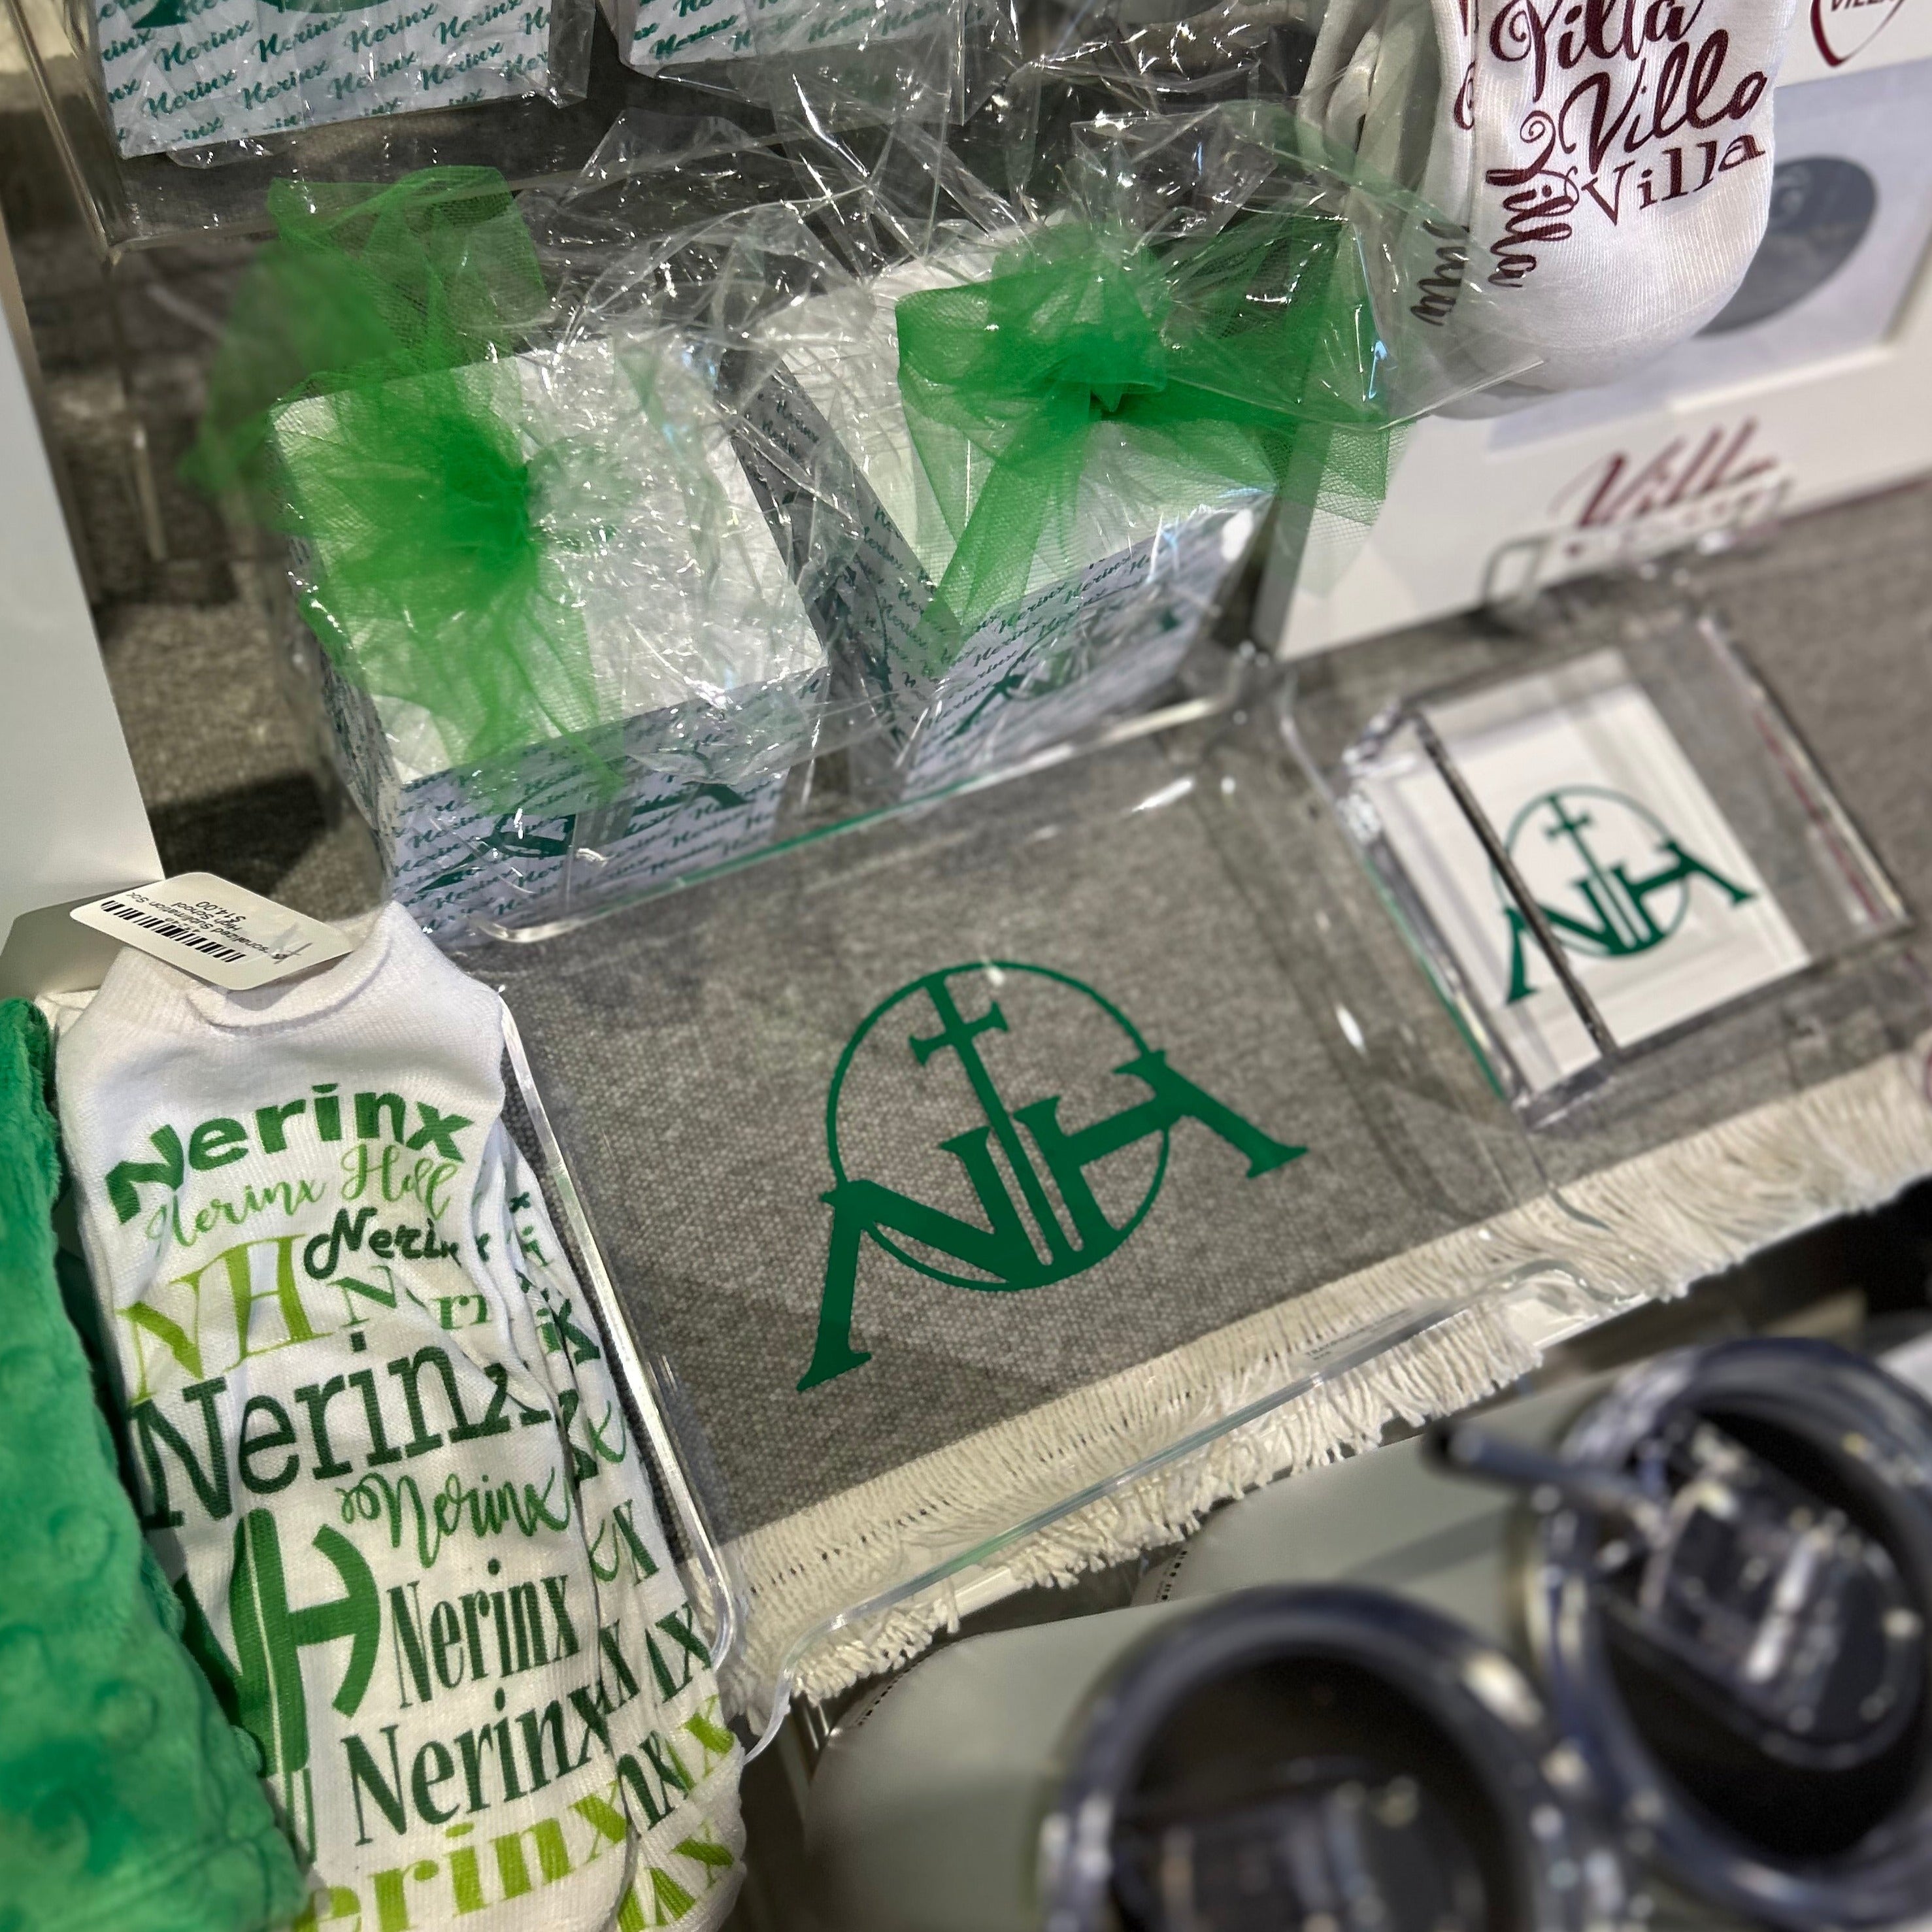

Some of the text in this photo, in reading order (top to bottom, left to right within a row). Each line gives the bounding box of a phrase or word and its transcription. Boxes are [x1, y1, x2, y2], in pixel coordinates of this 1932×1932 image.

[1581, 134, 1766, 226] Villa
[171, 901, 242, 931] High School
[195, 901, 246, 923] $14.00
[210, 927, 269, 954] sonalized
[106, 1082, 475, 1225] Nerinx
[115, 1233, 333, 1408] NH
[129, 1331, 552, 1530] Nerinx
[334, 1466, 572, 1569] Nerinx
[386, 1557, 581, 1709] Nerinx
[340, 1686, 616, 1848] Nerinx
[290, 1780, 627, 1932] erinx
